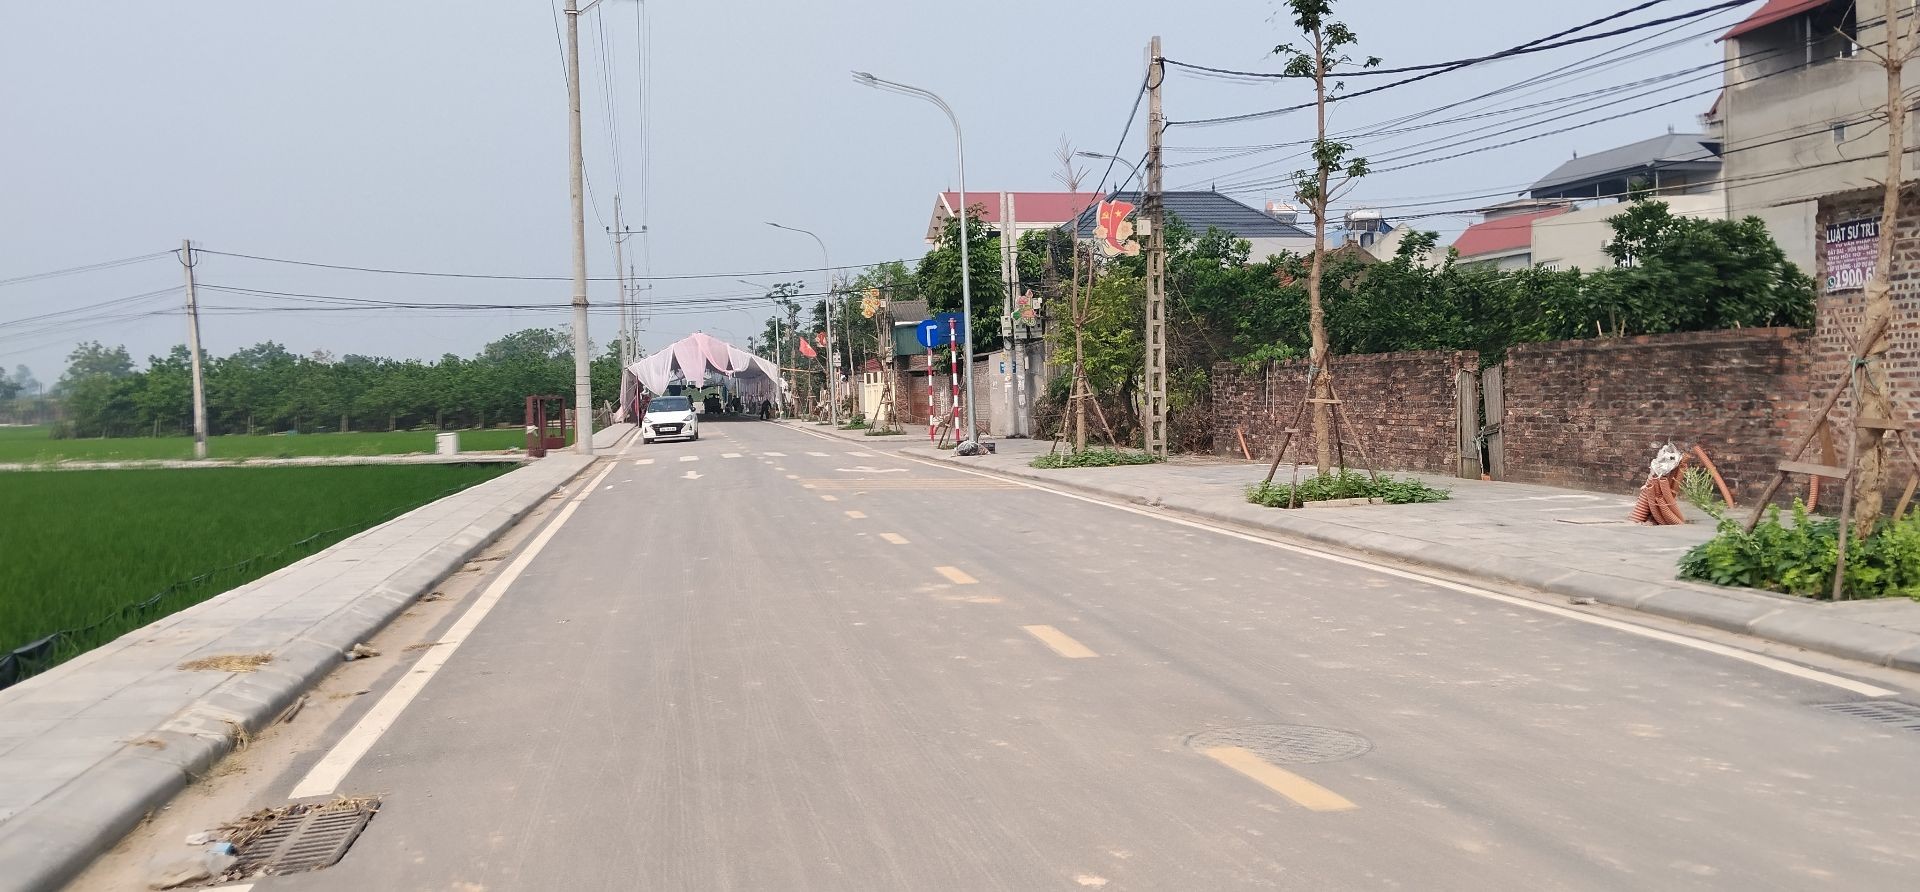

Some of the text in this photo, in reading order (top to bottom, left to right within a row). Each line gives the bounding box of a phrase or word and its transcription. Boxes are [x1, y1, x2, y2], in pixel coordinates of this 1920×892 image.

[1826, 224, 1846, 244] LUẬT
[1847, 222, 1860, 240] SƯ
[1860, 217, 1875, 238] TRÍ
